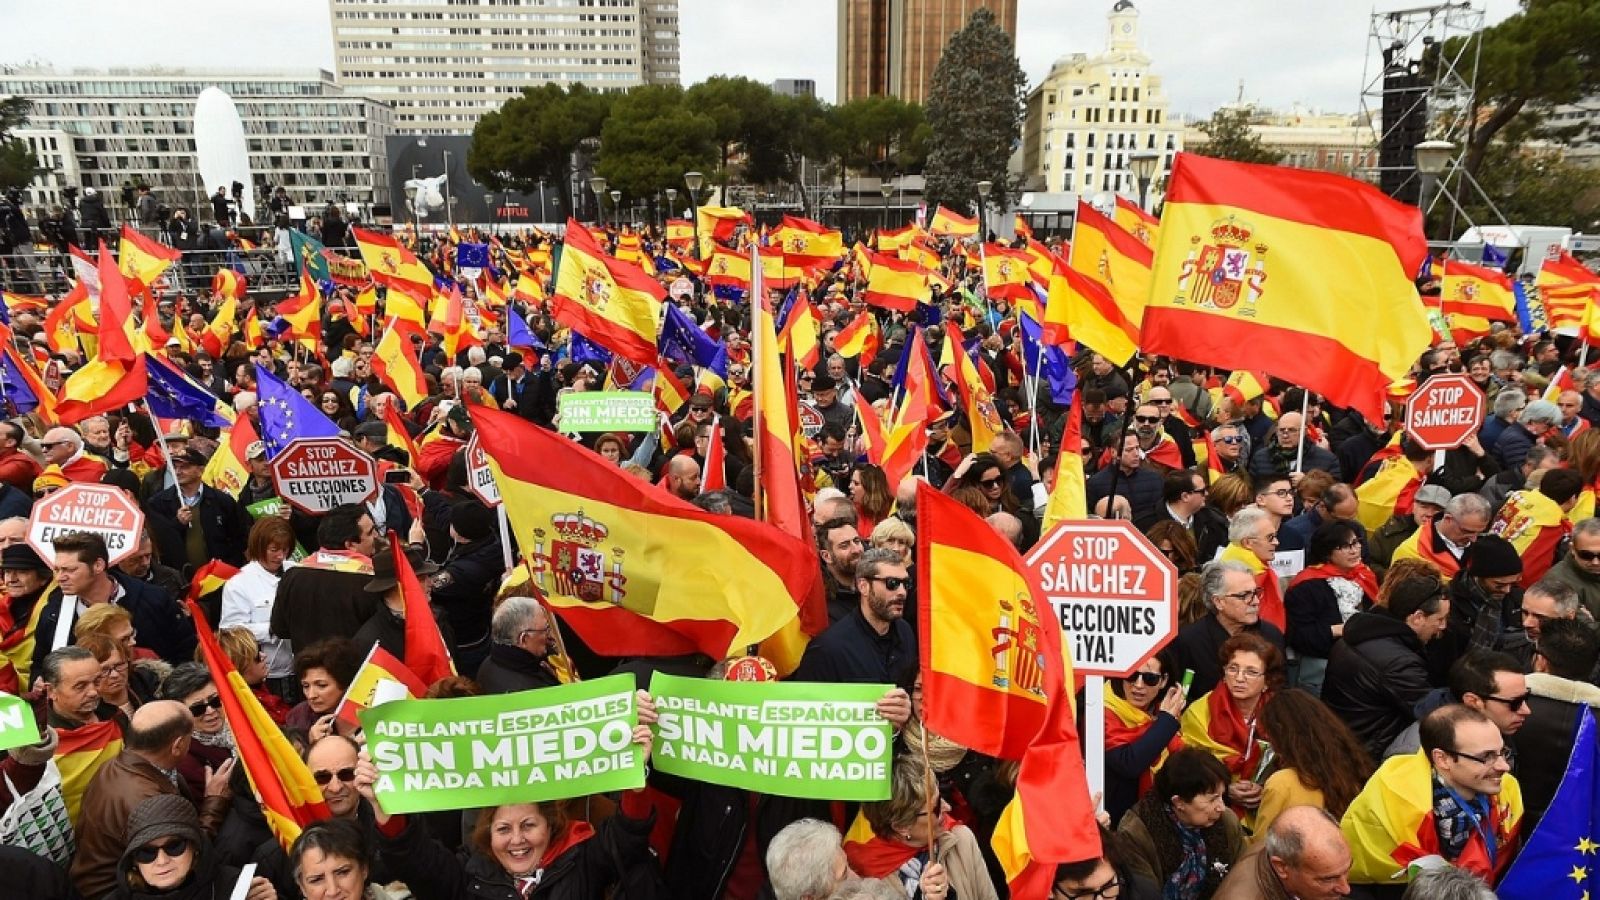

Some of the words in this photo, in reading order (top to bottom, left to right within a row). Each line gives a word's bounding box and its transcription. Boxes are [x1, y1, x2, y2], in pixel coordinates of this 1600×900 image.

[1429, 387, 1463, 405] STOP
[563, 407, 590, 417] SIN
[1413, 406, 1474, 427] SÁNCHEZ
[305, 446, 337, 459] STOP
[287, 457, 358, 476] SÁNCHEZ
[77, 491, 110, 506] STOP
[289, 480, 366, 495] ELECCIONES
[49, 501, 125, 527] SÁNCHEZ
[1072, 536, 1119, 560] STOP
[1040, 556, 1147, 595] SÁNCHEZ
[1076, 634, 1115, 663] ¡YA!
[374, 720, 494, 737] ADELANTE
[501, 698, 629, 732] ESPAÑOLES
[655, 696, 759, 721] ADELANTE
[374, 740, 455, 771] SIN
[471, 719, 632, 770] MIEDO
[658, 713, 723, 749] SIN
[738, 724, 887, 760] MIEDO
[375, 774, 395, 793] A
[404, 772, 485, 792] NADA
[491, 769, 519, 787] NI
[527, 767, 547, 784] A
[554, 751, 634, 780] NADIE
[660, 742, 676, 759] A
[681, 745, 747, 771] NADA
[753, 757, 778, 776] NI
[784, 761, 803, 779] A
[810, 762, 886, 780] NADIE
